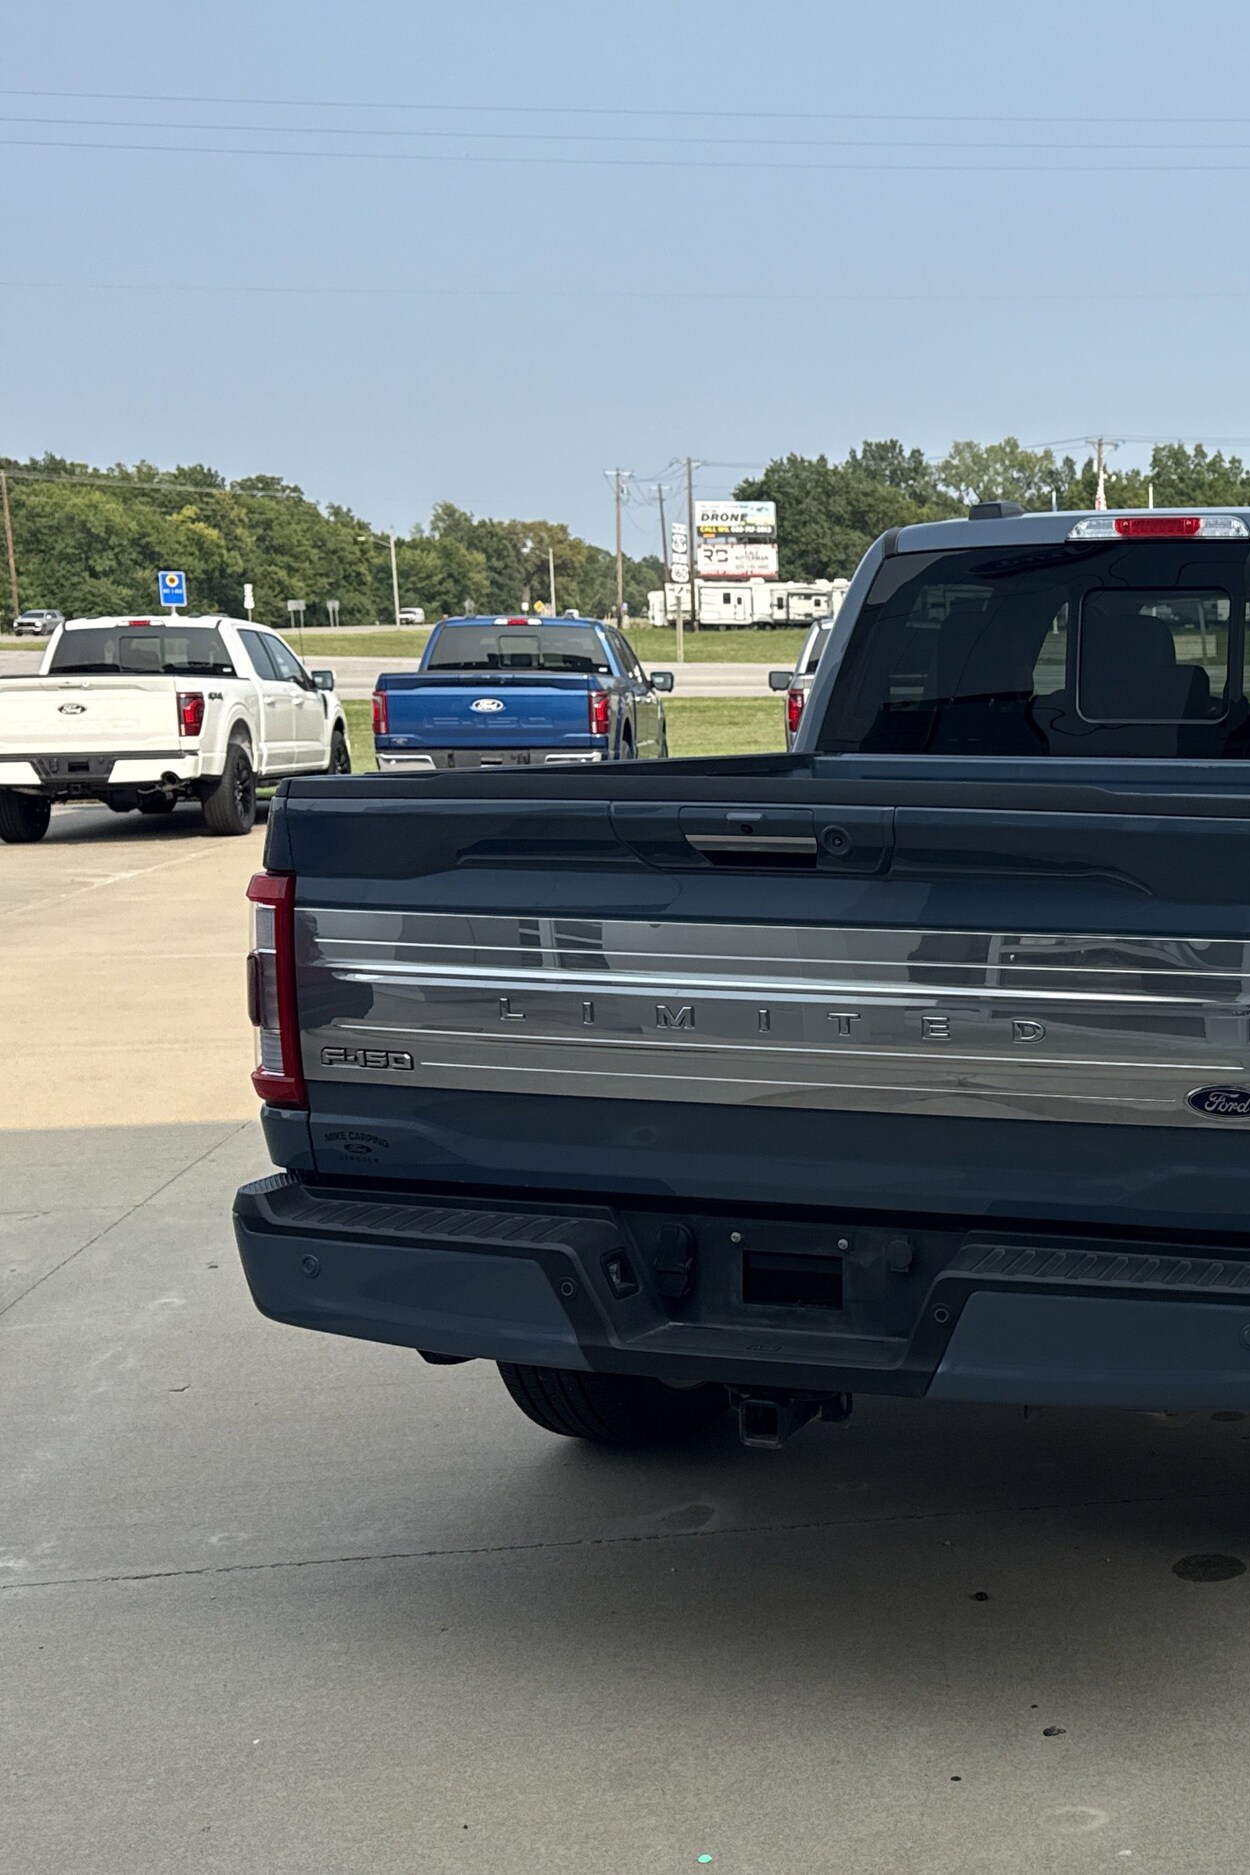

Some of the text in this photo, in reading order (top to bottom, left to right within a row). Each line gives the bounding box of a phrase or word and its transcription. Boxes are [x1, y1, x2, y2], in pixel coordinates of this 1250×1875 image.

[499, 997, 1047, 1044] LIMITED
[321, 1046, 415, 1071] F-150
[324, 1131, 389, 1148] MIKE CARPINO
